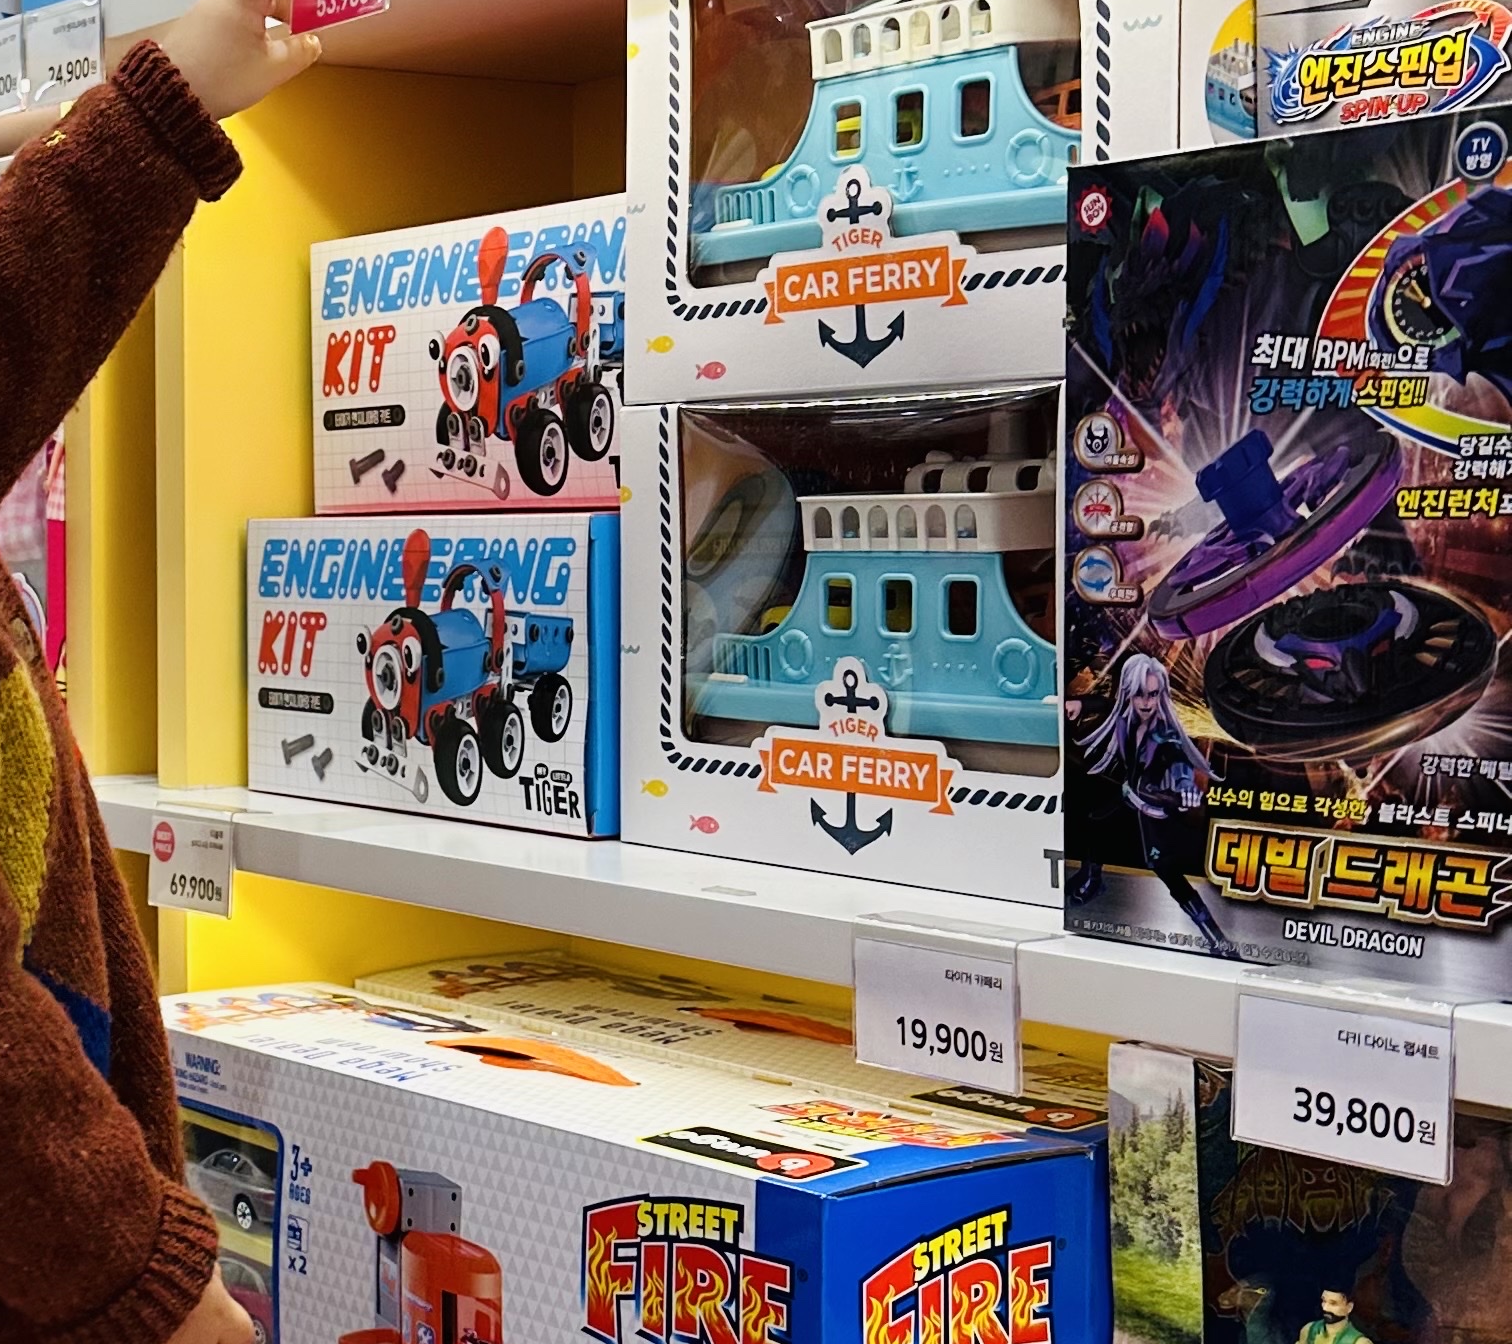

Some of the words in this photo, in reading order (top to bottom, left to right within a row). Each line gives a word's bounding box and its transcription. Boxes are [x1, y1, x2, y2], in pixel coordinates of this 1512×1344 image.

[1351, 20, 1429, 47] ENGINE
[1300, 32, 1470, 104] 엔진스핀업
[1340, 94, 1390, 122] SPIN
[1398, 93, 1428, 114] UP
[1472, 136, 1490, 152] TV
[1084, 196, 1101, 214] SUN
[1087, 203, 1104, 223] BOY
[833, 228, 883, 252] TIGER
[784, 272, 840, 303] CAR
[848, 259, 941, 294] FERRY
[323, 325, 396, 397] KIT
[1252, 334, 1308, 369] 최대
[1250, 378, 1352, 413] 강력하게
[1460, 436, 1512, 457] 당길수
[1397, 488, 1499, 517] 엔진런처
[259, 610, 327, 677] KIT
[829, 719, 879, 742] TIGER
[779, 749, 833, 780] CAR
[842, 755, 930, 792] FERRY
[1422, 756, 1474, 777] 강력한
[519, 776, 581, 818] TIGER
[1206, 787, 1253, 808] 신수의
[1260, 790, 1308, 812] 힘으로
[1378, 803, 1450, 826] 블라스트
[1216, 832, 1312, 897] 데빌
[1327, 841, 1491, 918] 드래곤
[1284, 921, 1337, 945] DEVIL
[1341, 929, 1423, 957] DRAGON
[945, 969, 971, 985] 타이거
[974, 974, 1002, 990] 카페리
[896, 1016, 1004, 1065] 19,900원
[1364, 1033, 1400, 1053] 다이노
[1293, 1087, 1437, 1147] 39,800원
[290, 1144, 313, 1181] 3+
[637, 1201, 738, 1241] STREET
[912, 1211, 1008, 1280] STREET
